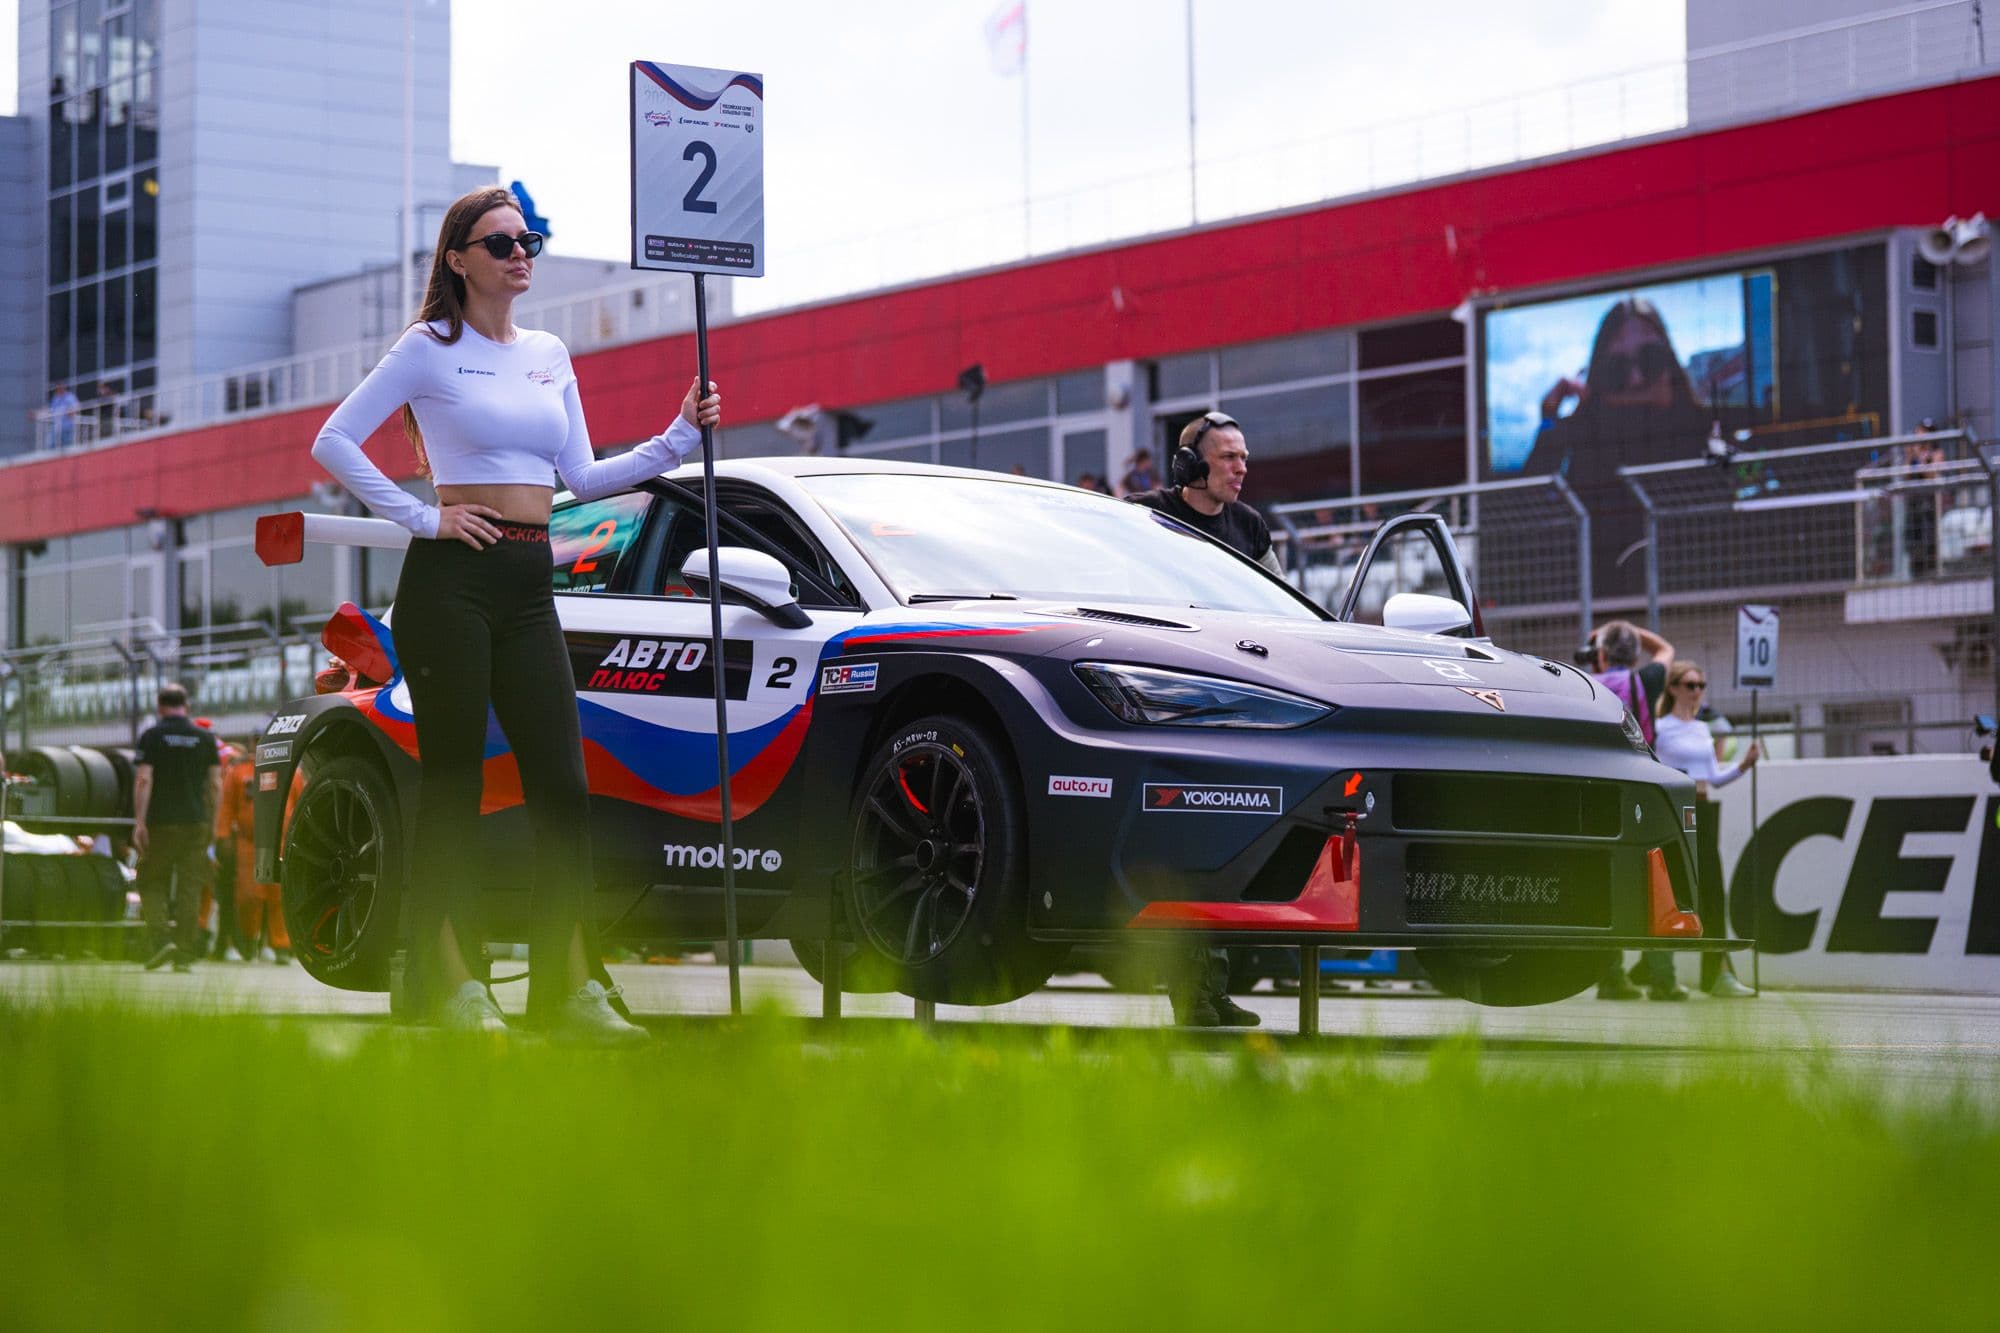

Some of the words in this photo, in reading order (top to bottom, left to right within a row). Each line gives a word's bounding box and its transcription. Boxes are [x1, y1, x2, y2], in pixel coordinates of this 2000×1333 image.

[683, 140, 717, 214] 2
[571, 519, 617, 574] 2
[600, 639, 707, 671] АВТО
[1747, 636, 1770, 667] 10
[588, 669, 666, 691] ПЛЮС
[765, 656, 798, 689] 2
[825, 667, 851, 685] TCR
[850, 669, 875, 679] Russia
[1052, 778, 1109, 793] auto.ru
[1182, 790, 1271, 808] YOKOHAMA
[1460, 873, 1561, 903] RACING
